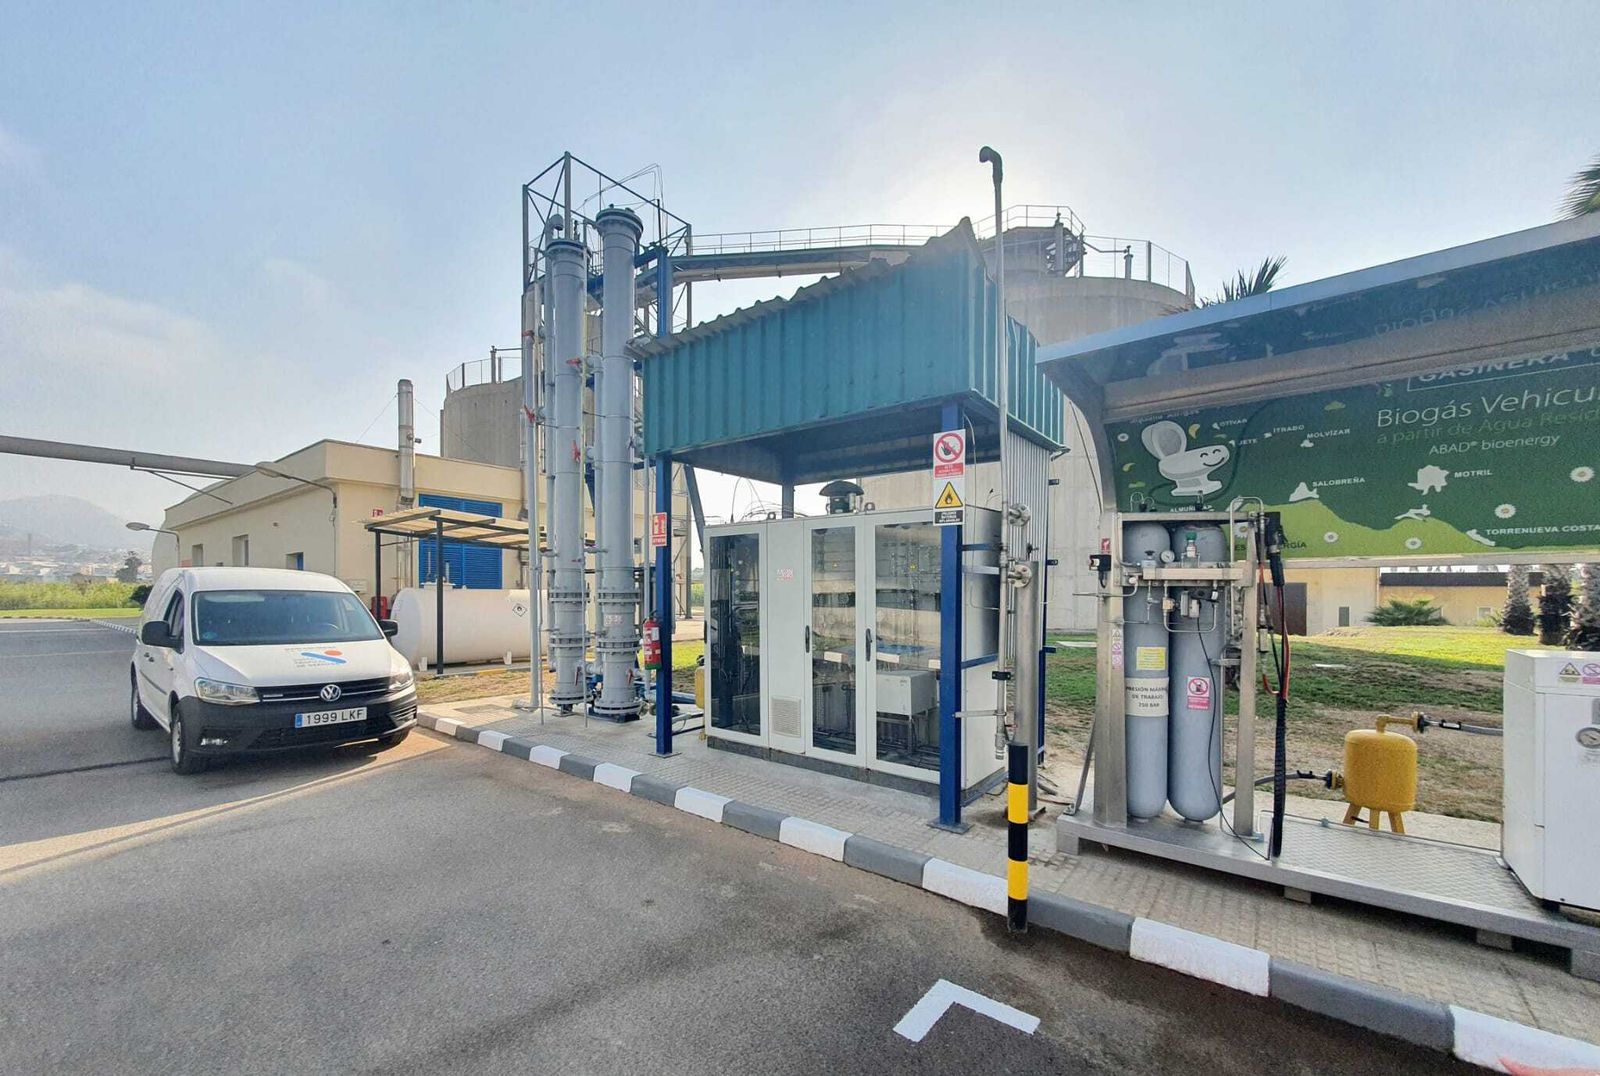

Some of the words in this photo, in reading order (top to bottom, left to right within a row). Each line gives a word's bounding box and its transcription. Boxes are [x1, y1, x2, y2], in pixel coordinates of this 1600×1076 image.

[1377, 399, 1472, 428] Biogás
[1481, 386, 1600, 415] Vehicu
[1392, 427, 1442, 445] partir
[1447, 422, 1473, 436] de
[1478, 413, 1533, 434] Agua
[1481, 434, 1561, 451] bioenergy
[1312, 476, 1366, 488] SALOBREÑA
[1454, 469, 1493, 478] MOTRIL
[1486, 525, 1558, 536] TORRENUEVA
[1561, 523, 1600, 533] COSTA
[306, 712, 338, 725] 1999
[341, 708, 364, 721] LKF
